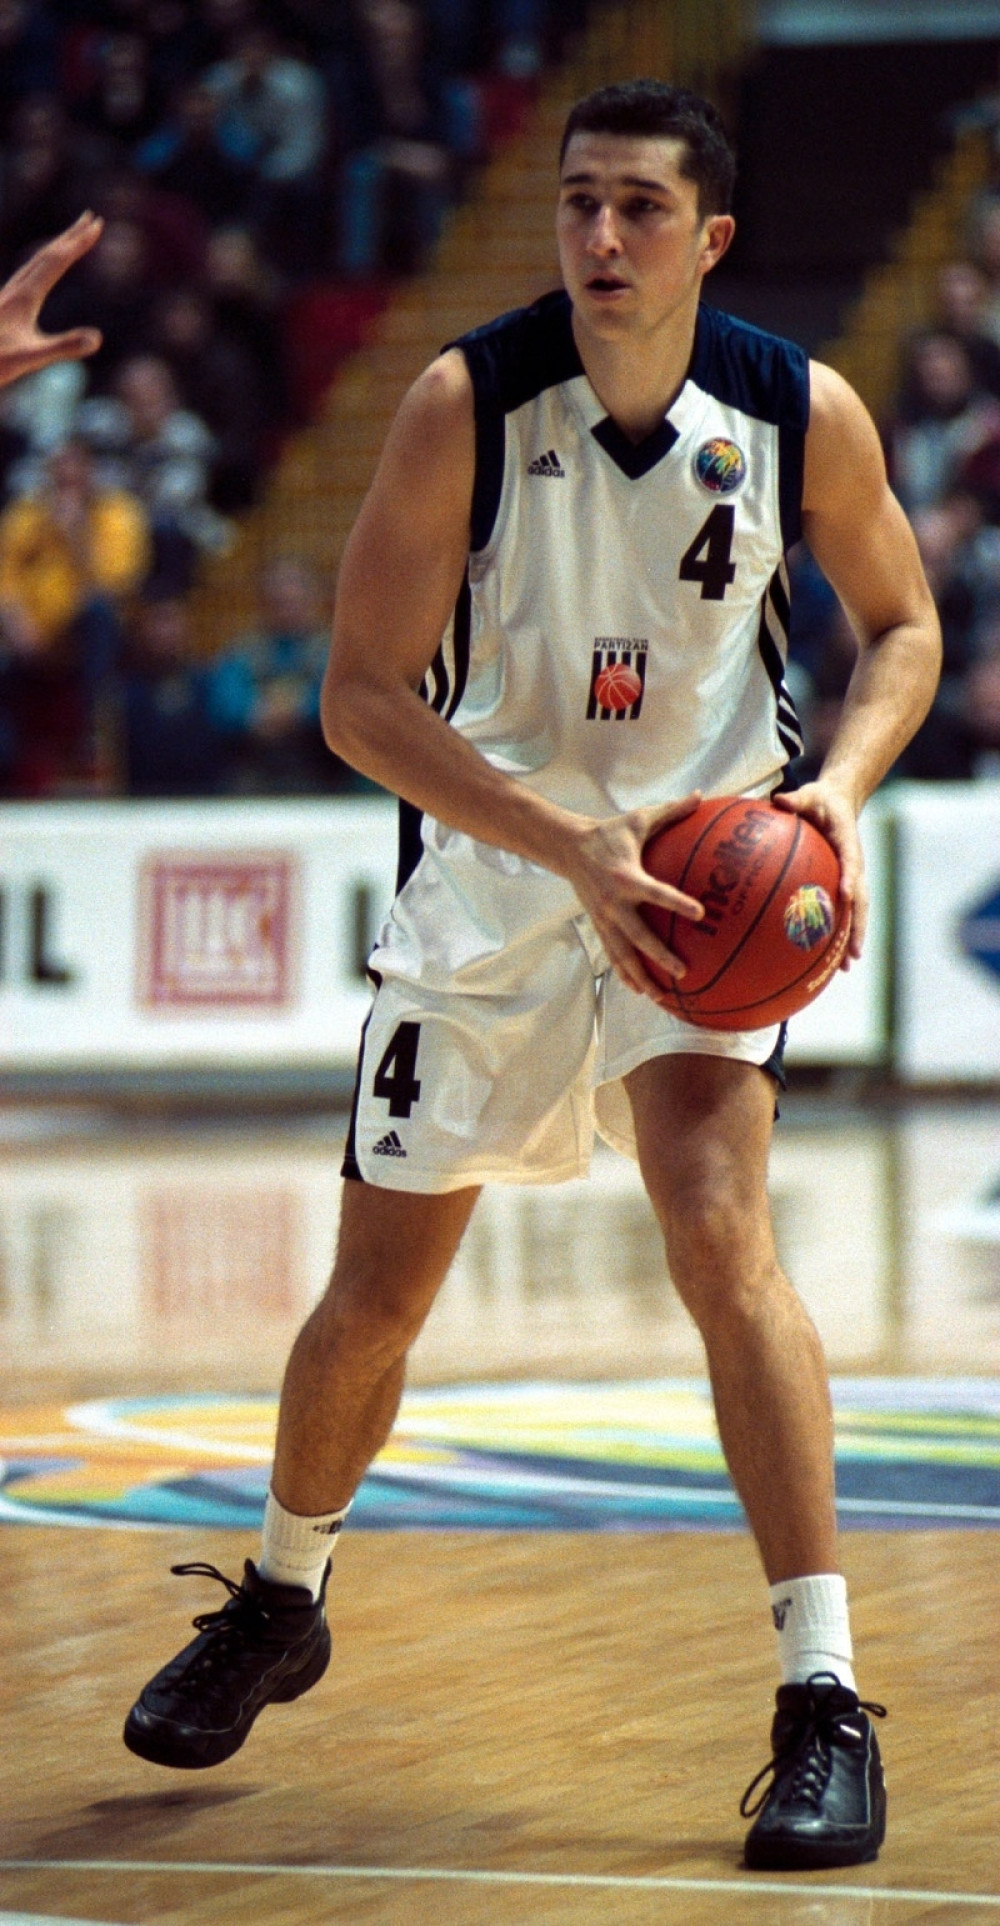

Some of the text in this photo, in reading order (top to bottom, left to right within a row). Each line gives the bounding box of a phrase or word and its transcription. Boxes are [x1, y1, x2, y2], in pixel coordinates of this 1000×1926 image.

[527, 465, 565, 478] adidas
[679, 504, 736, 600] 4
[594, 640, 649, 651] PARTIZAN
[693, 809, 775, 937] molten
[373, 1021, 421, 1118] 4
[372, 1145, 407, 1158] adidas
